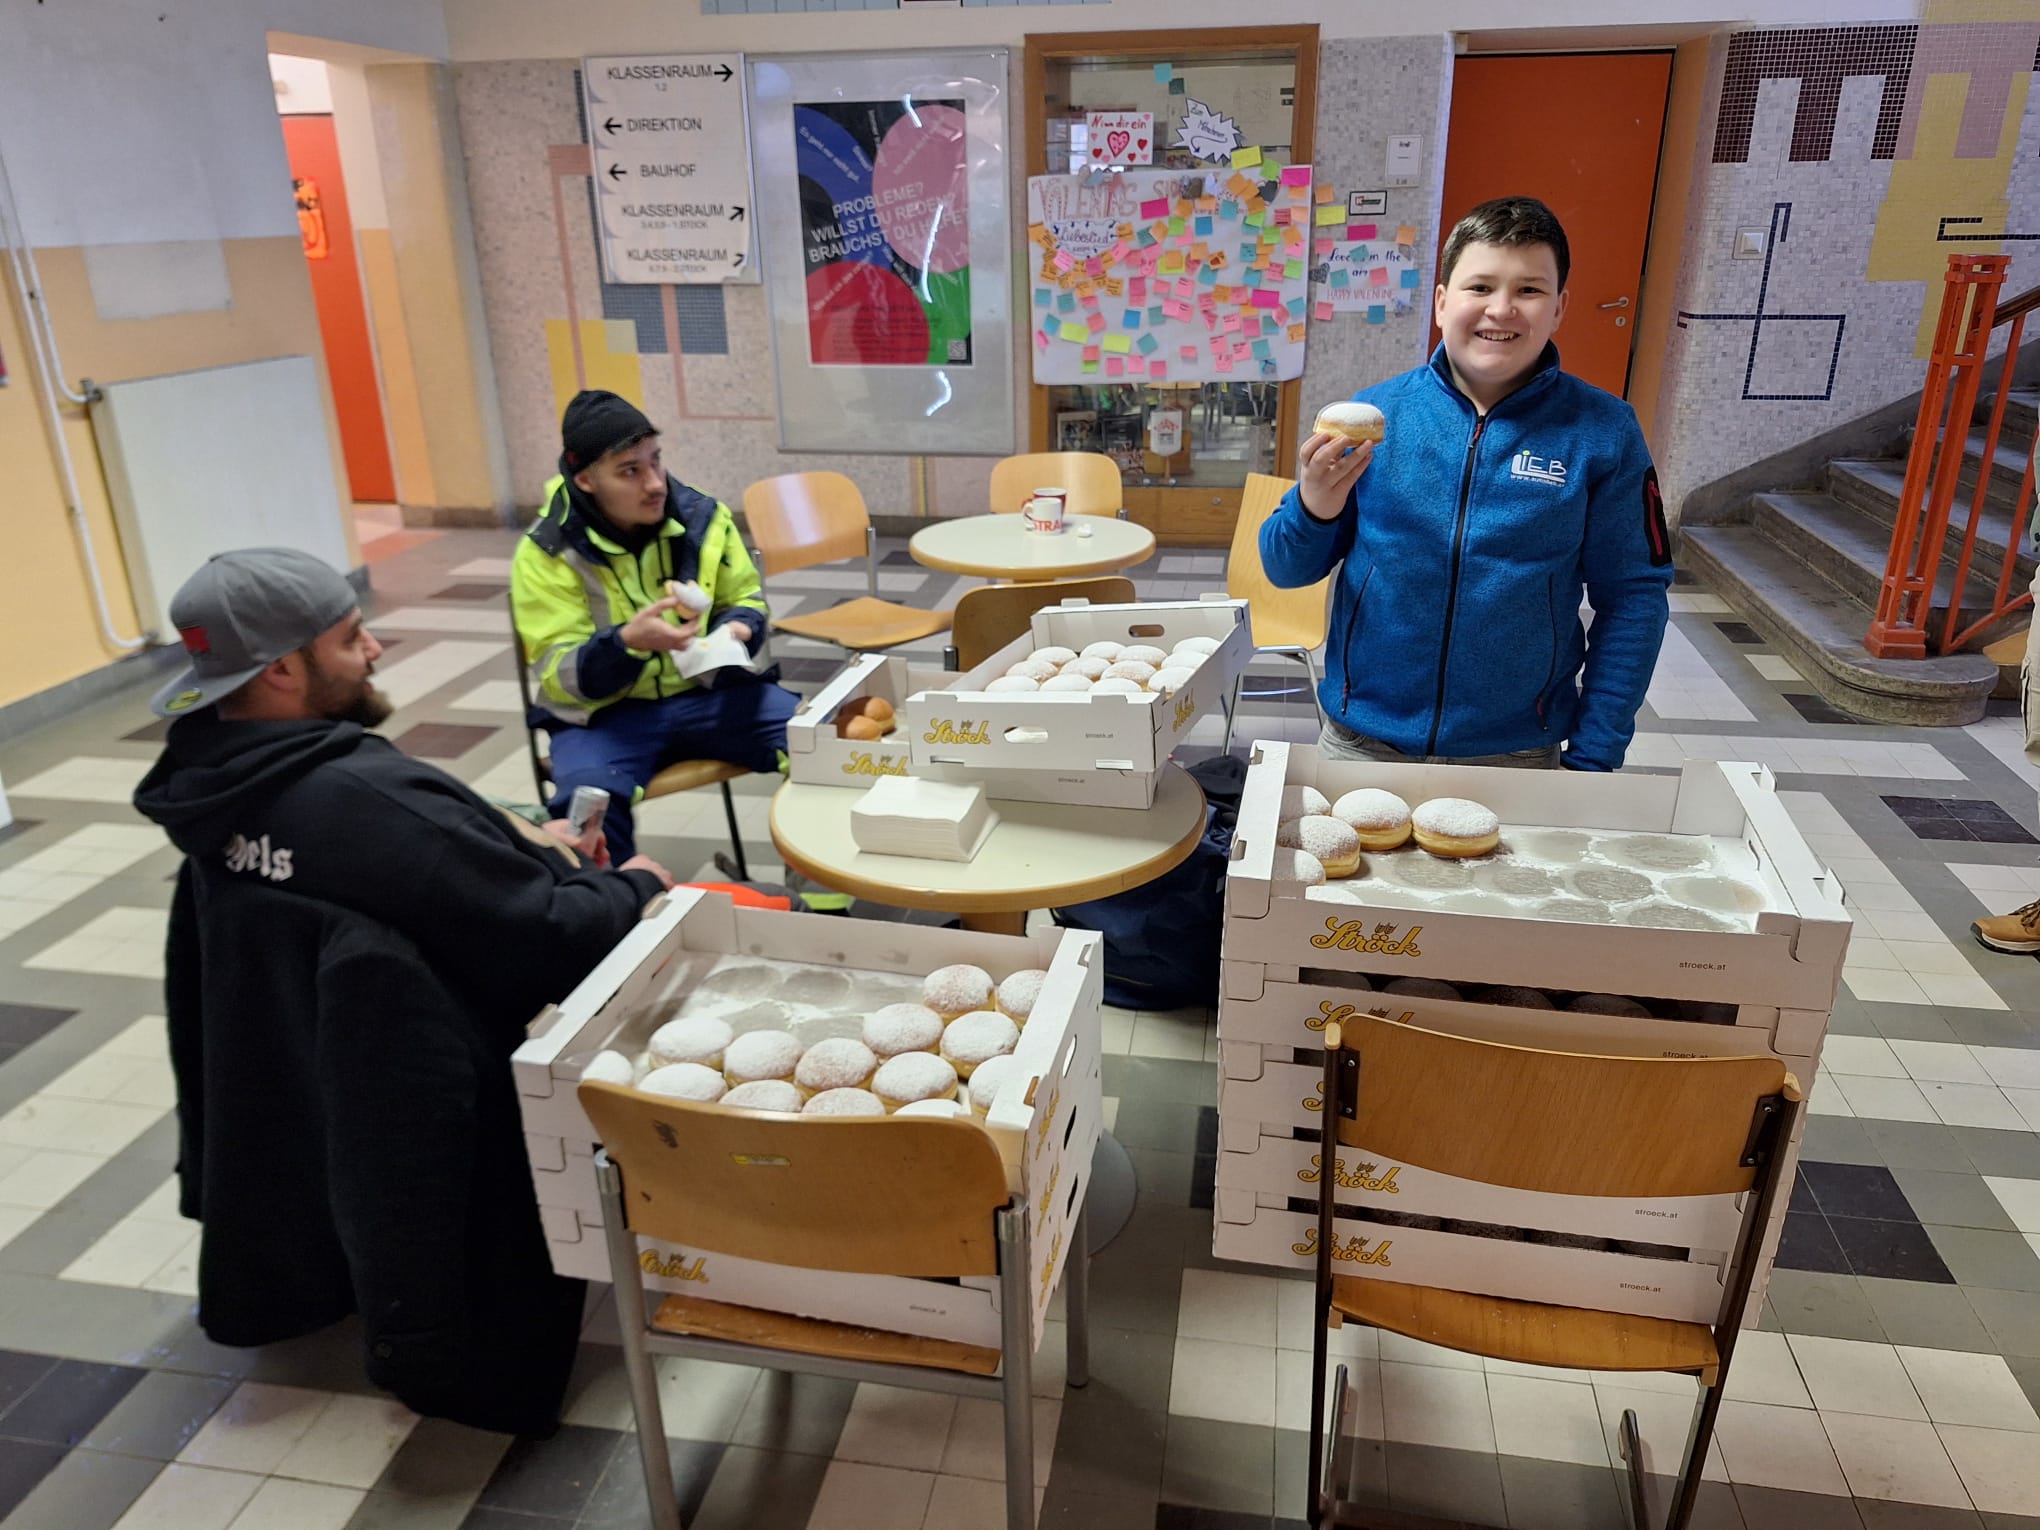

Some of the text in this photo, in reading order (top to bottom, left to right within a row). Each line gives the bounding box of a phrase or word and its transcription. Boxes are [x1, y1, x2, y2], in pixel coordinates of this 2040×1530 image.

[607, 64, 712, 80] KLASSENRAUM
[626, 117, 702, 132] DIREKTION
[1116, 114, 1130, 128] dir
[1131, 119, 1147, 129] ein
[640, 164, 697, 178] BAUHOF
[831, 182, 925, 219] PROBLEME?
[621, 203, 726, 219] KLASSENRAUM
[811, 217, 867, 244] WILLST
[868, 209, 893, 230] DU
[808, 230, 889, 264] BRAUCHST
[893, 224, 917, 242] DU
[627, 248, 729, 263] KLASSENRAUM
[923, 717, 992, 745] Ströck
[841, 750, 909, 776] Ströck
[1310, 916, 1423, 957] Ströck
[1679, 961, 1726, 971] stroeck.at
[1635, 1208, 1678, 1219] stroeck.at
[1620, 1282, 1661, 1293] stroeck.at
